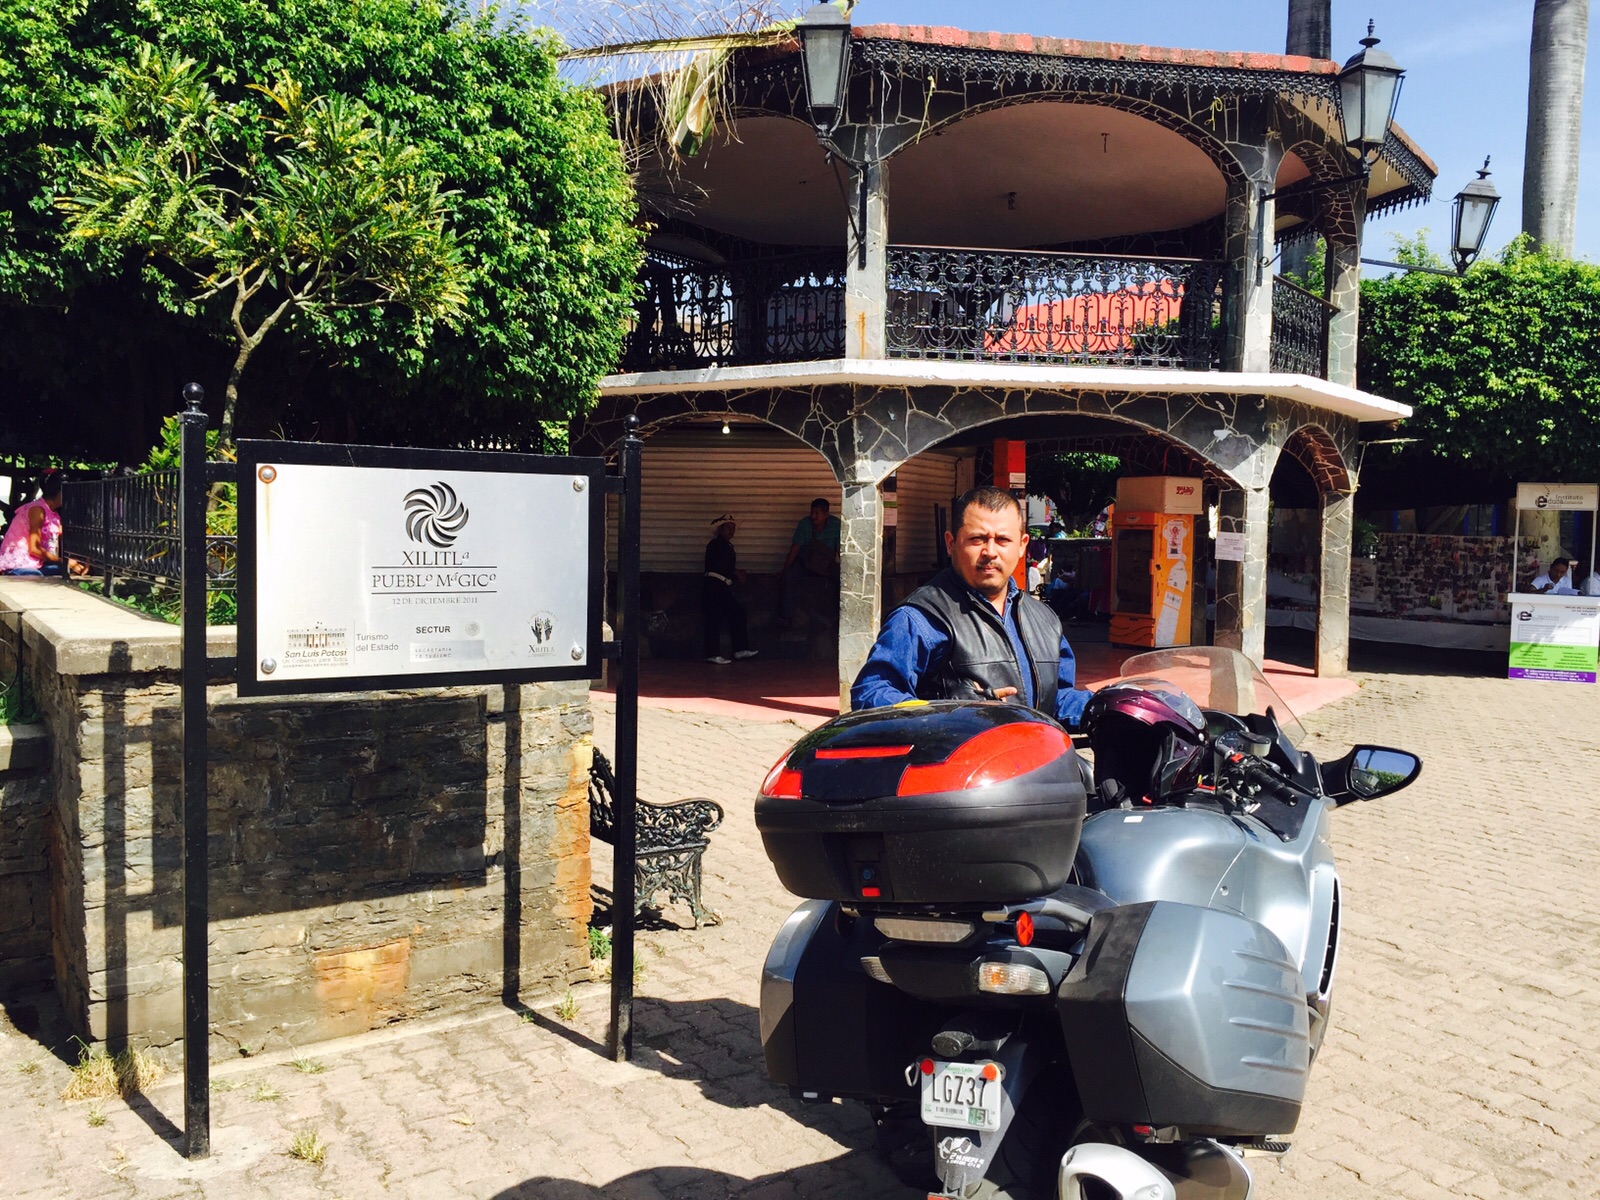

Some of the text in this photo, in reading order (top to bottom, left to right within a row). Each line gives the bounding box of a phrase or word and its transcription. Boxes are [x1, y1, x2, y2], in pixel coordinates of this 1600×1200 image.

[462, 596, 478, 604] 2011
[415, 625, 451, 634] SECTUR
[356, 633, 389, 641] Turismo
[356, 643, 399, 652] del Estado
[285, 650, 301, 658] San
[302, 649, 320, 657] Luis
[932, 1073, 988, 1107] LGZ37
